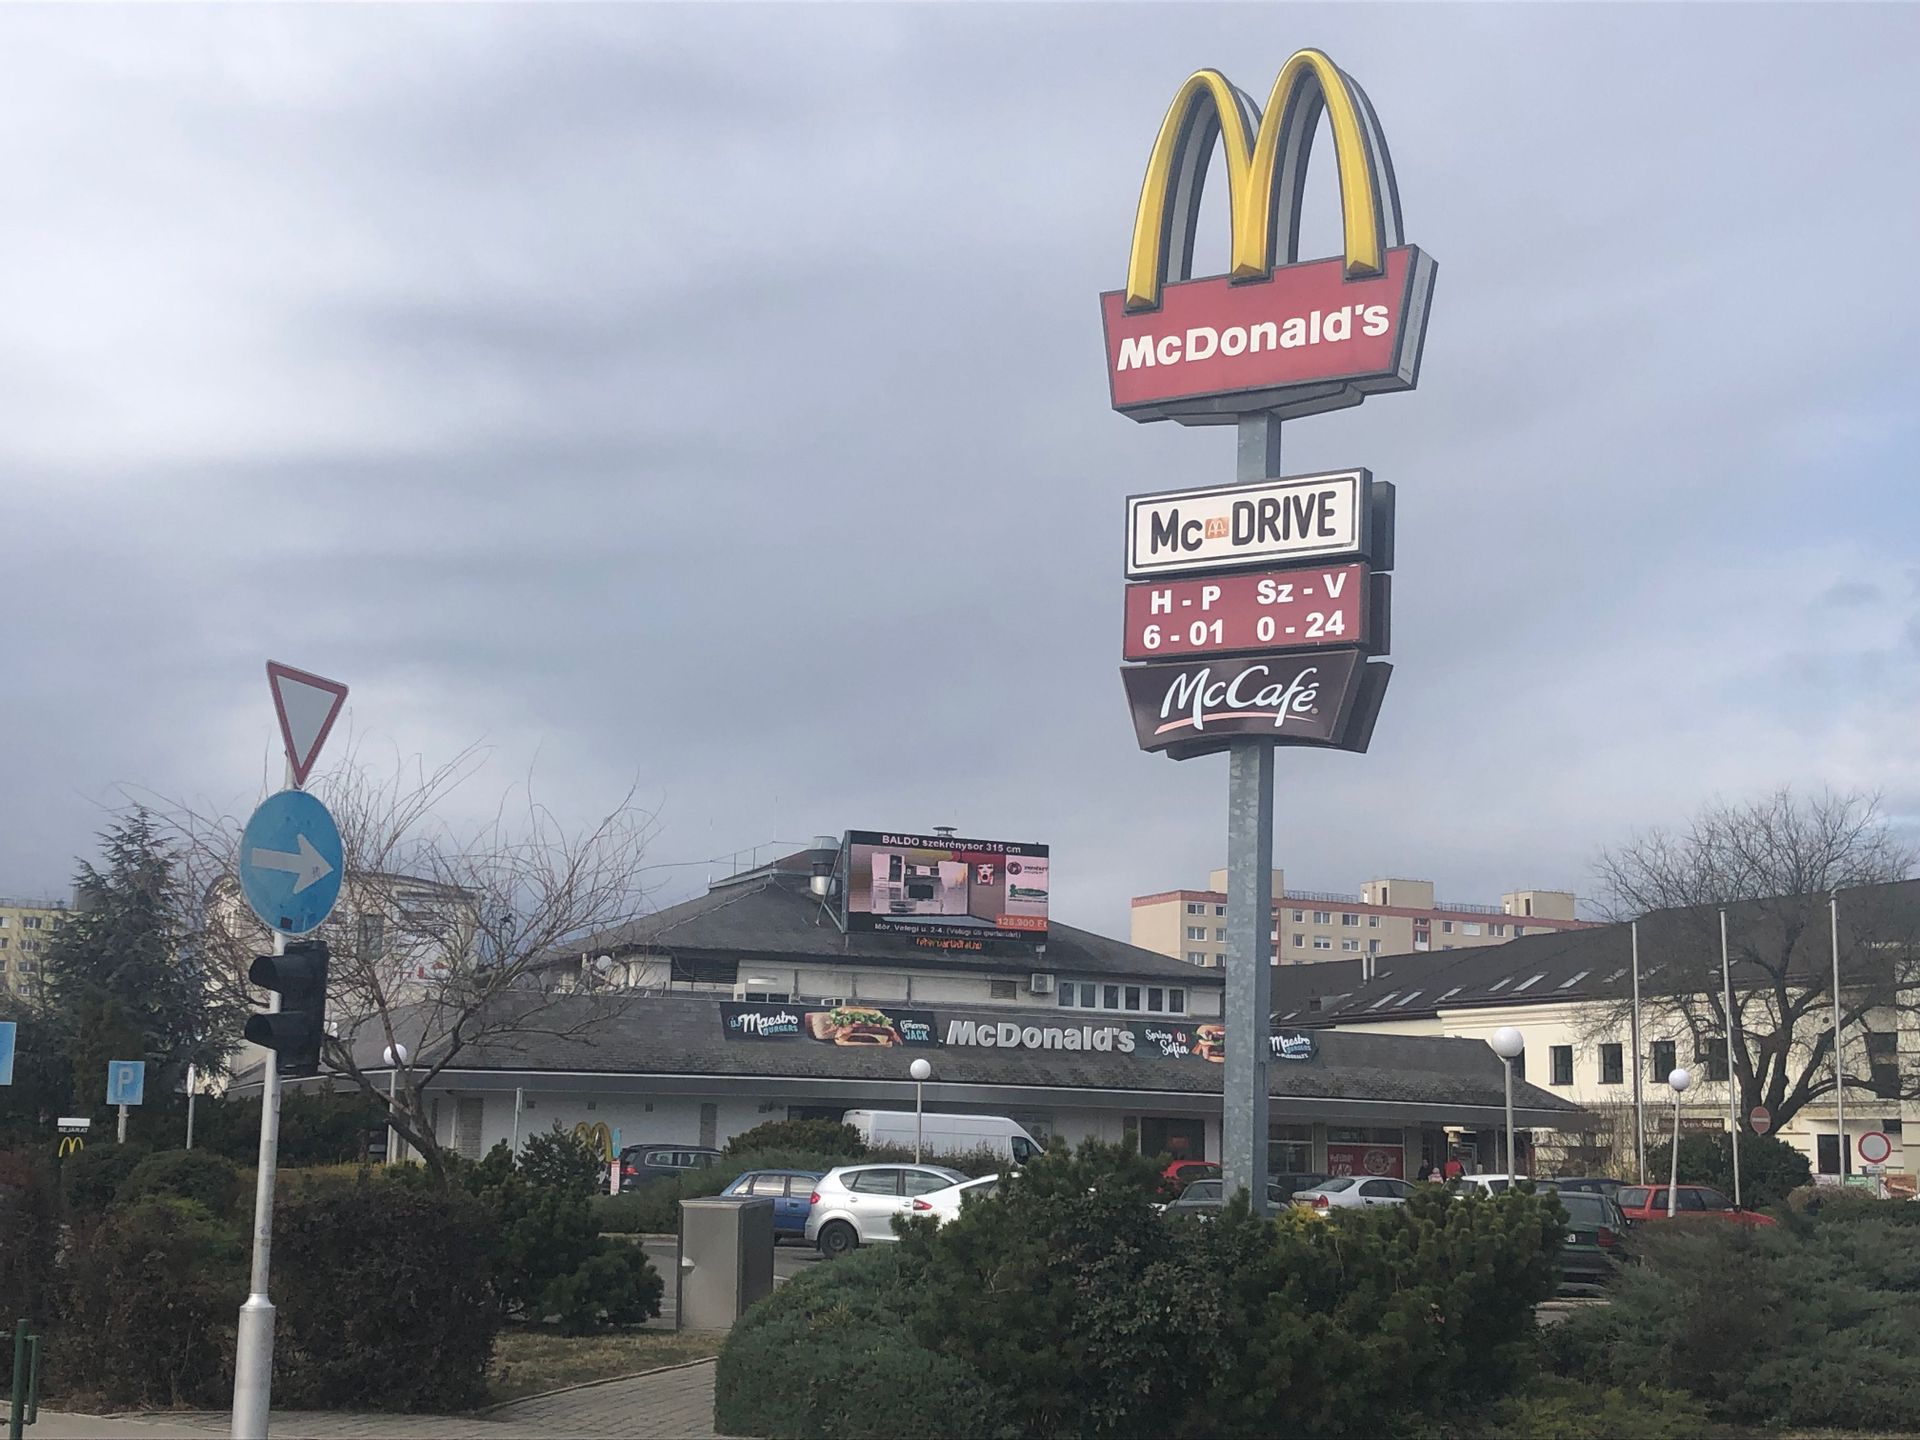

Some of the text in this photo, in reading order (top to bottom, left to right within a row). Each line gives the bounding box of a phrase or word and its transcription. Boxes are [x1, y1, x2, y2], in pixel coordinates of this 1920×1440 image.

[1116, 304, 1390, 371] McDonald's
[1150, 490, 1337, 555] Mc DRIVE
[1150, 589, 1172, 615] H
[1201, 585, 1222, 611] P
[1256, 579, 1294, 605] Sz
[1322, 572, 1347, 598] V
[1142, 624, 1161, 650] 6
[1189, 618, 1224, 646] 01
[1256, 616, 1276, 642] 0
[1305, 610, 1345, 638] 24
[1159, 665, 1320, 730] McCafé
[882, 834, 1021, 854] BALDO szekrénysor 315 cm
[738, 1010, 799, 1036] Maestro
[762, 1024, 799, 1037] BURGERS
[905, 1029, 930, 1041] JACK
[946, 1020, 1136, 1053] McDonald's
[1159, 1039, 1190, 1059] Sofia
[1268, 1033, 1311, 1054] Maestro
[117, 1067, 134, 1097] P
